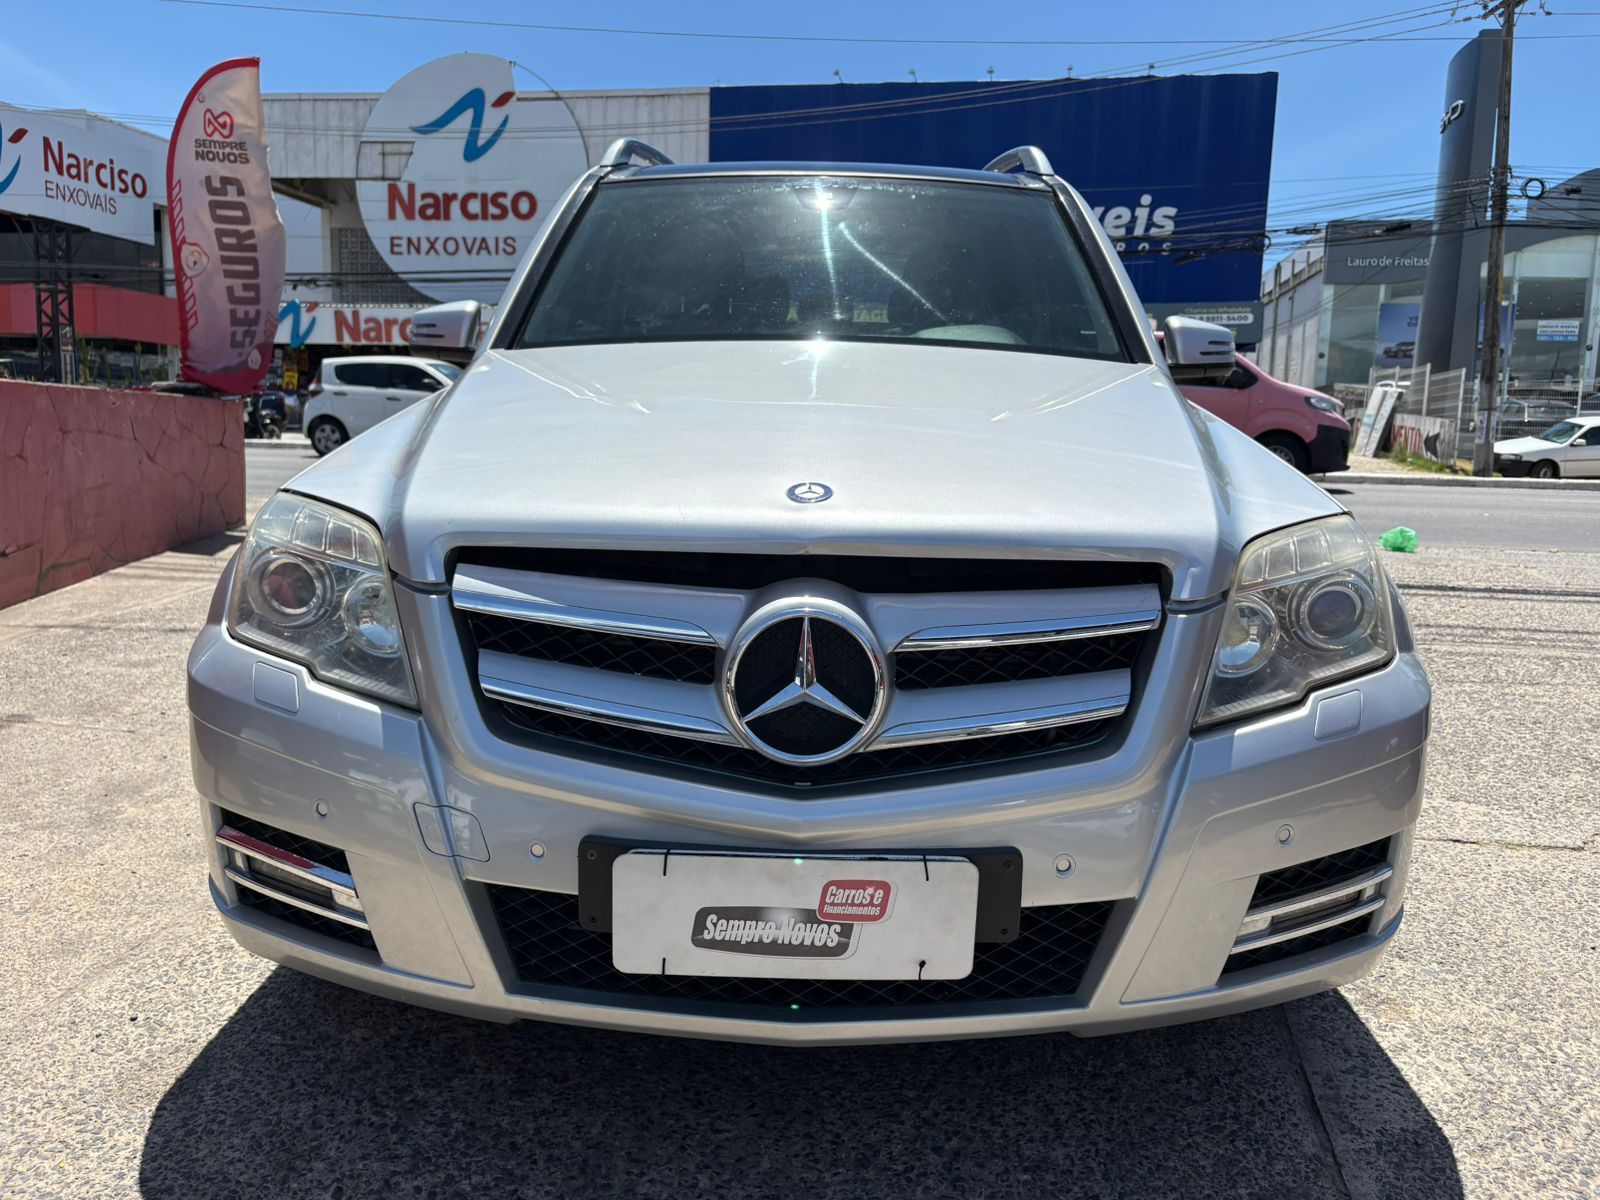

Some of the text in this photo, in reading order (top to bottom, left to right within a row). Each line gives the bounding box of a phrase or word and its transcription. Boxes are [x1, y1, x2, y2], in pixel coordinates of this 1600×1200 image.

[195, 138, 248, 151] SEMPRE
[43, 136, 147, 198] Narciso
[195, 150, 249, 164] NOVOS
[45, 180, 117, 215] ENXOVAIS
[388, 183, 538, 221] Narciso
[390, 236, 517, 256] ENXOVAIS
[205, 174, 262, 355] SEGUROS
[1347, 256, 1430, 267] Lauro de Freitas
[825, 885, 884, 905] Carros e
[823, 904, 881, 916] Financiamentos
[703, 914, 841, 947] Sempre Novos
